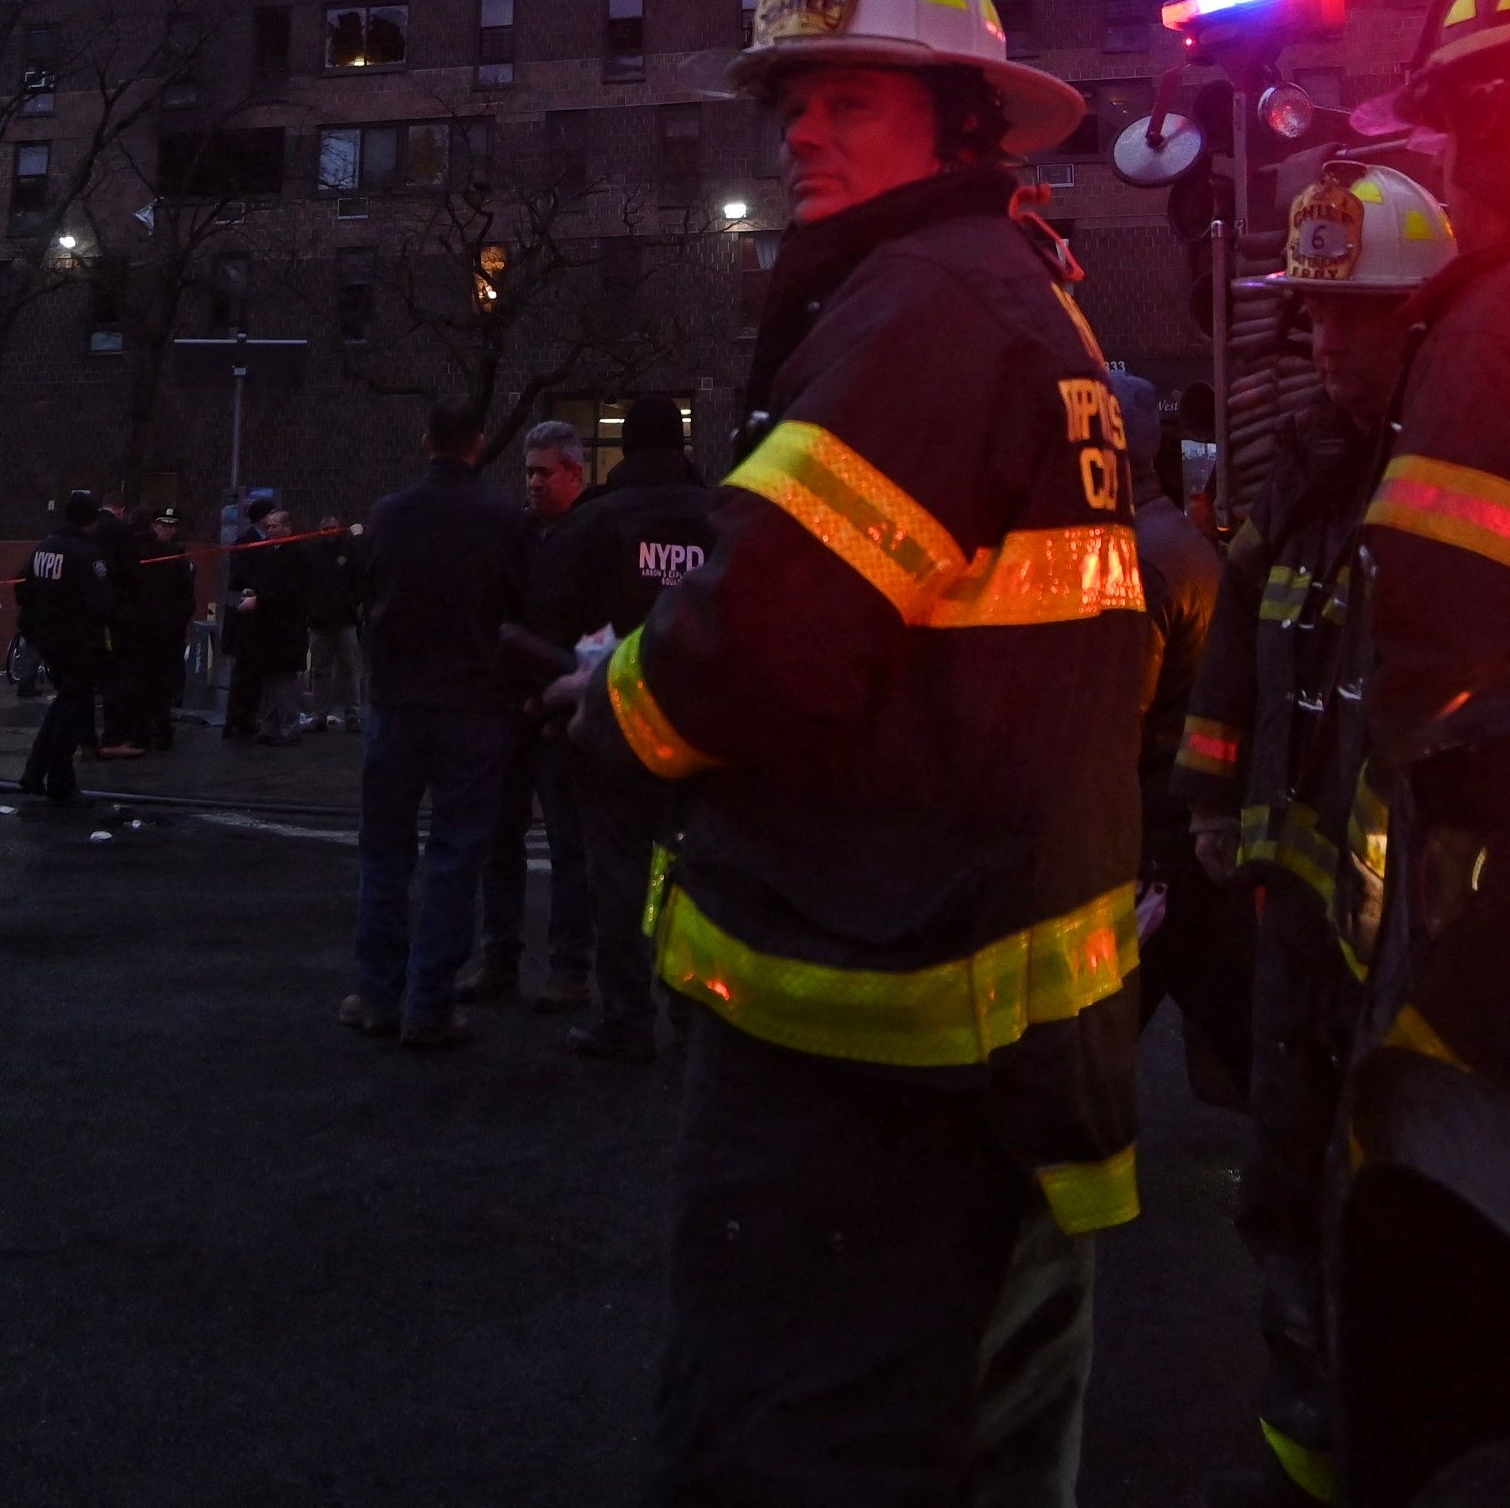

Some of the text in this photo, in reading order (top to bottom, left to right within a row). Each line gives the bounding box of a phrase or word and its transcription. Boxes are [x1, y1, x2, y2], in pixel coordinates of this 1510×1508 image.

[1312, 225, 1327, 249] 6
[34, 551, 64, 580] NYPD
[639, 542, 704, 572] NYPD
